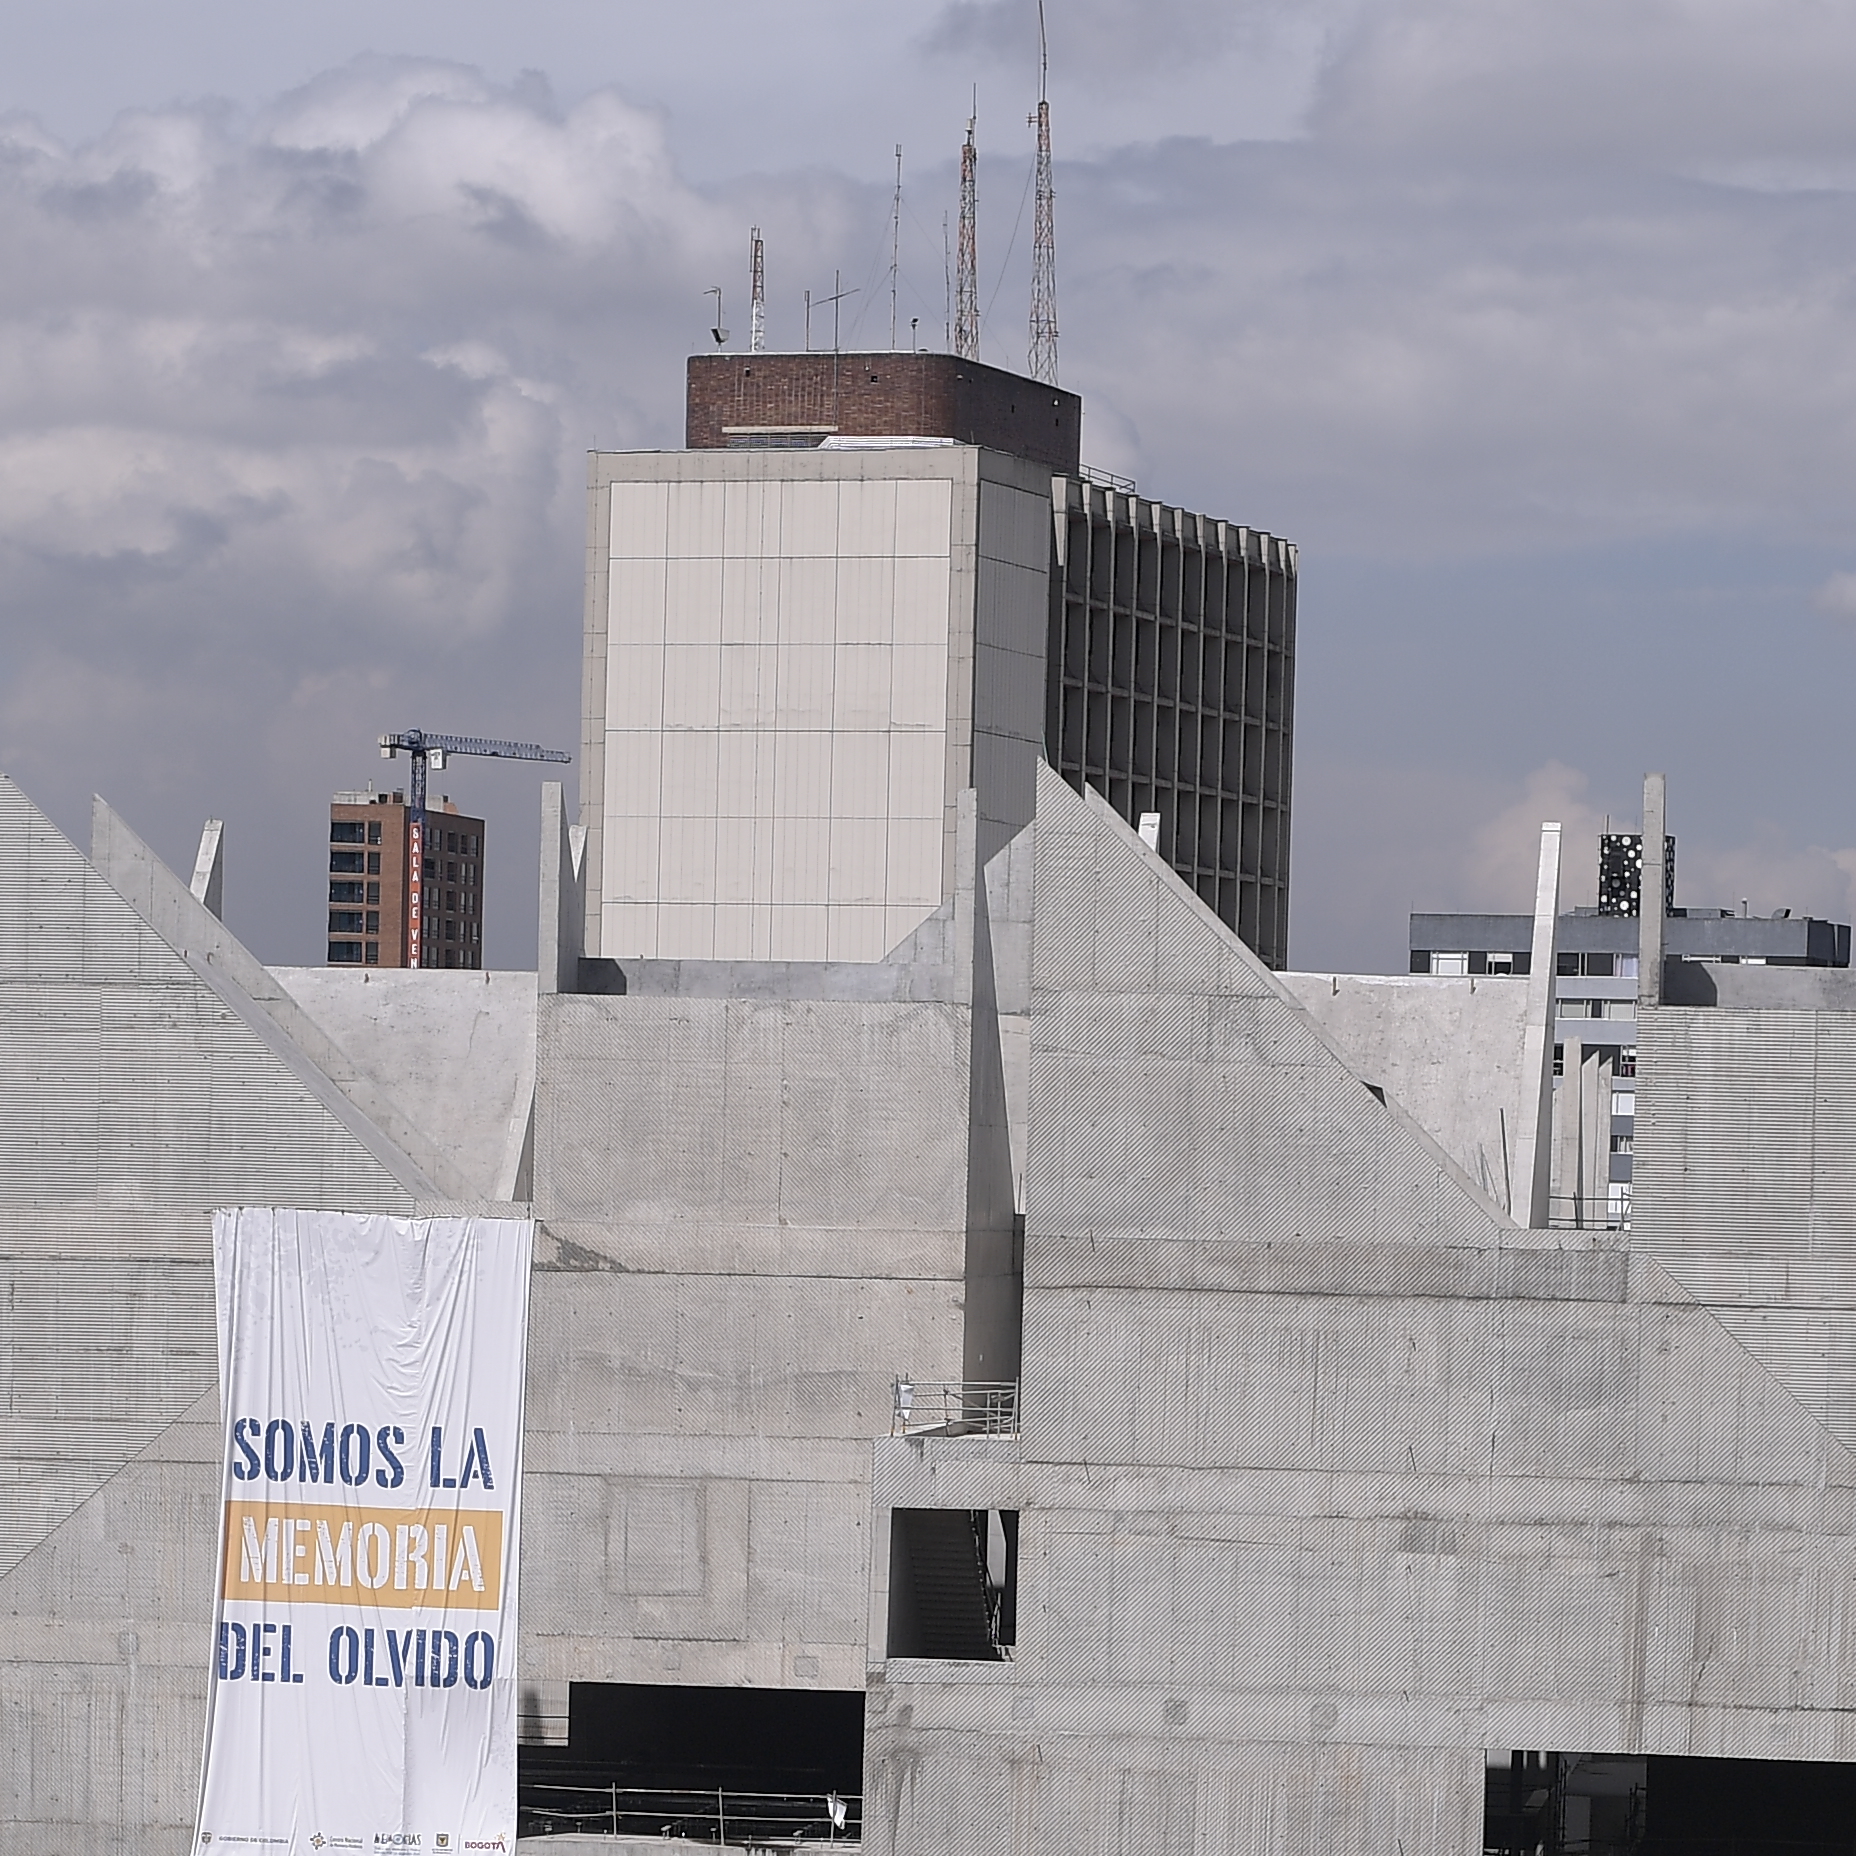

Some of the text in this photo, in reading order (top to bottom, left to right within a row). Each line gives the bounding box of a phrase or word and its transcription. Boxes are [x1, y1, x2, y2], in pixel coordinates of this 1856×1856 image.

[412, 828, 420, 882] SALA
[411, 893, 419, 918] DE
[232, 1417, 495, 1490] SOMOS LA
[239, 1515, 486, 1593] MEMORIA
[218, 1621, 495, 1690] DEL OLVIDO
